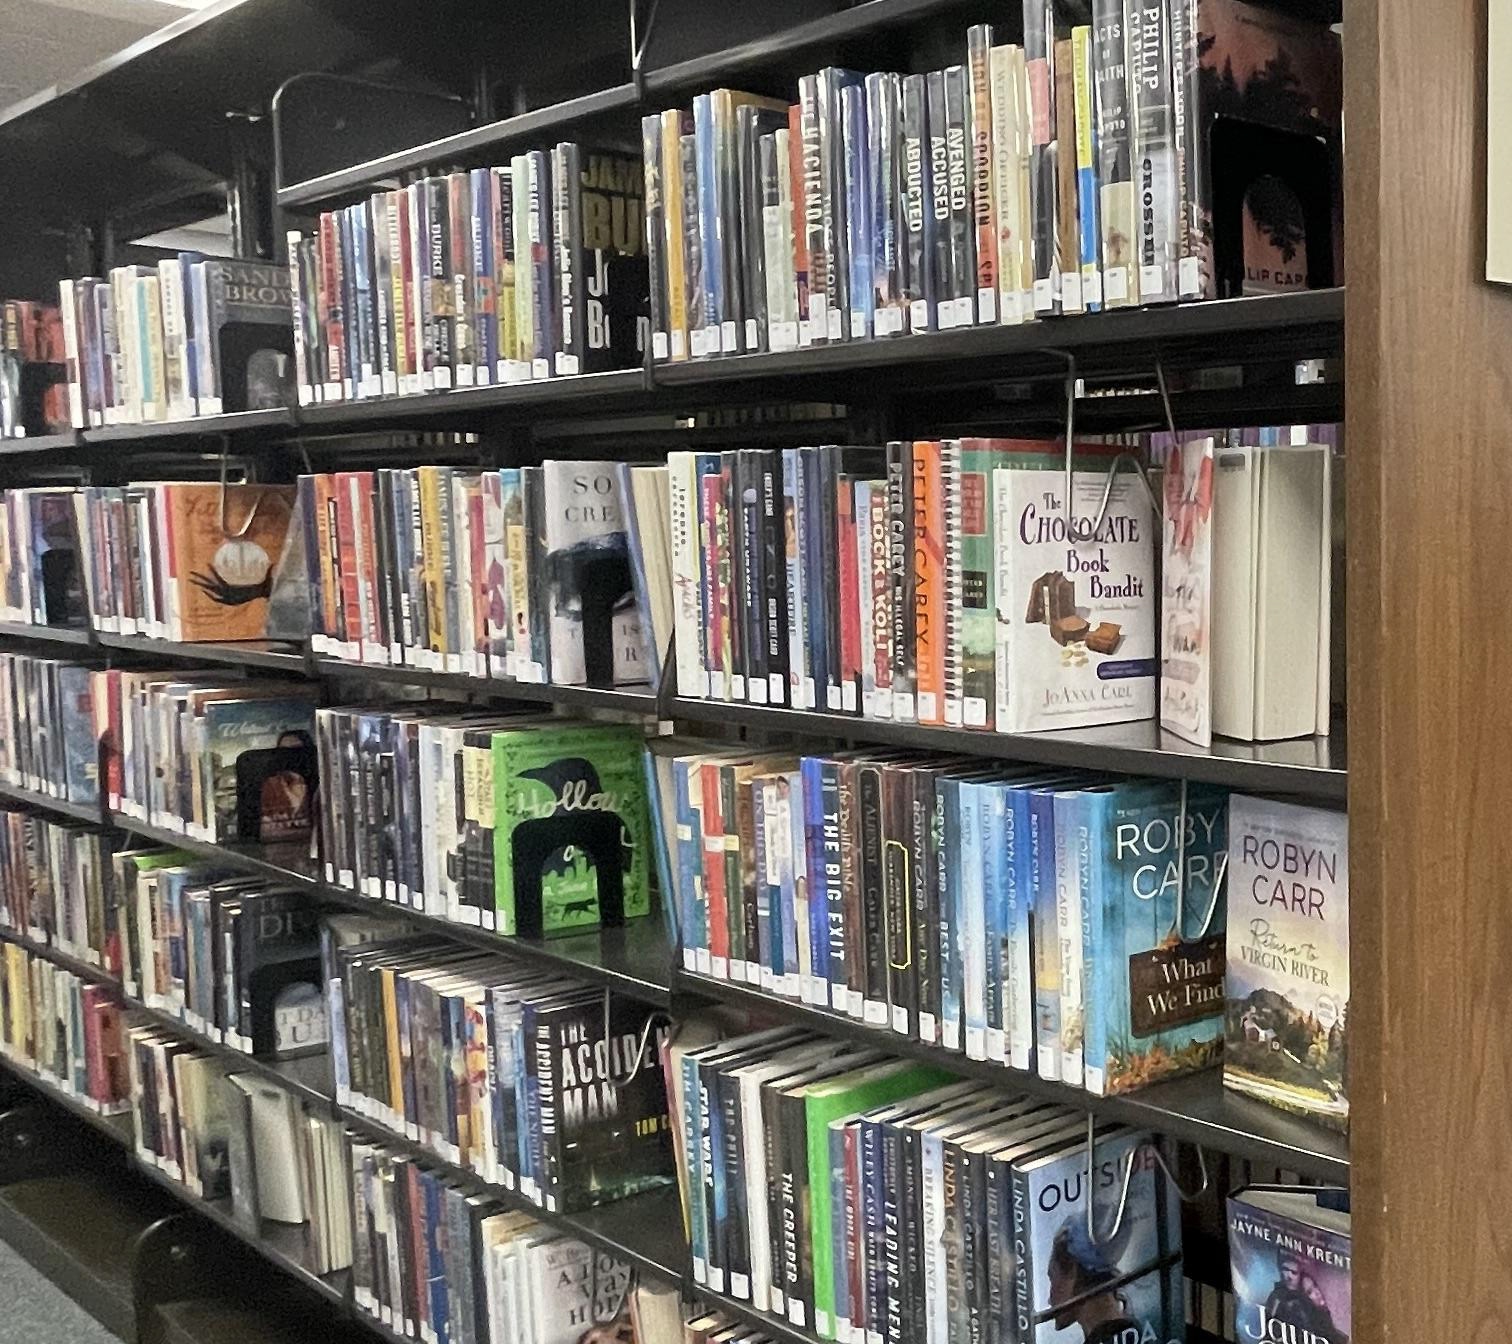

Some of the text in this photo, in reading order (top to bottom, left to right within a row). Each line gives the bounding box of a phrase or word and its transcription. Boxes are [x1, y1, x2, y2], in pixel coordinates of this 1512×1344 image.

[1142, 6, 1160, 89] PHILIP
[802, 127, 823, 234] HACIENDA
[906, 138, 923, 232] ABDUCTED
[931, 136, 948, 220] ACCUSED
[947, 127, 966, 211] AVENGED
[431, 224, 443, 276] BURKE
[220, 266, 291, 287] SAND
[225, 285, 292, 304] BROW
[573, 475, 613, 495] SO
[890, 462, 903, 514] PETER
[1043, 492, 1061, 510] The
[891, 520, 905, 577] CAREY
[913, 458, 929, 646] PETER CAREY
[1066, 549, 1110, 573] Book
[768, 598, 776, 618] ORSON
[1090, 574, 1144, 599] Bandit
[769, 619, 777, 638] SCOTT
[769, 639, 778, 656] CARD
[874, 594, 889, 650] KOLI
[895, 604, 904, 641] ILLEGAL
[896, 644, 905, 666] SELF
[865, 803, 878, 865] ALIENIST
[912, 800, 924, 860] ROBYN
[1005, 808, 1015, 863] ROBYN
[1031, 814, 1040, 892] ROBYN CARR
[1116, 809, 1220, 860] ROBY
[1057, 823, 1068, 927] ROBYN CARR
[1079, 826, 1090, 888] ROBYN
[1242, 835, 1337, 885] ROBYN
[824, 813, 844, 961] THE BIG EXIT
[914, 864, 925, 911] CARR
[936, 795, 951, 997] ROBYN CARR BEST US
[1007, 867, 1017, 910] CARR
[1252, 875, 1325, 921] CARR
[1250, 918, 1319, 961] Return to
[1163, 958, 1212, 984] What
[1240, 946, 1330, 987] VIRGIN RIVER
[1146, 978, 1225, 1016] We Find
[560, 1023, 588, 1047] THE
[562, 1026, 669, 1088] ACCIDE
[537, 1025, 556, 1135] THE ACCIDENT MAN
[563, 1081, 618, 1124] MAN
[699, 1080, 714, 1188] STAR WARS
[864, 1128, 876, 1178] WILEY
[866, 1183, 879, 1226] CASH
[944, 1150, 956, 1208] LINDA
[962, 1175, 973, 1217] LINDA
[781, 1173, 797, 1283] THE CREEPER
[924, 1167, 937, 1292] BREAKING SILENCE
[987, 1187, 1000, 1314] HER LAST BREATH
[1012, 1177, 1028, 1330] LINDA CASTILLO
[1231, 1219, 1272, 1242] JAYNE
[1275, 1234, 1303, 1253] ANN
[1306, 1244, 1351, 1270] KRENT
[884, 1200, 901, 1339] LEADING MEN
[945, 1215, 959, 1312] CASTILLO
[964, 1222, 975, 1291] CASTILLO
